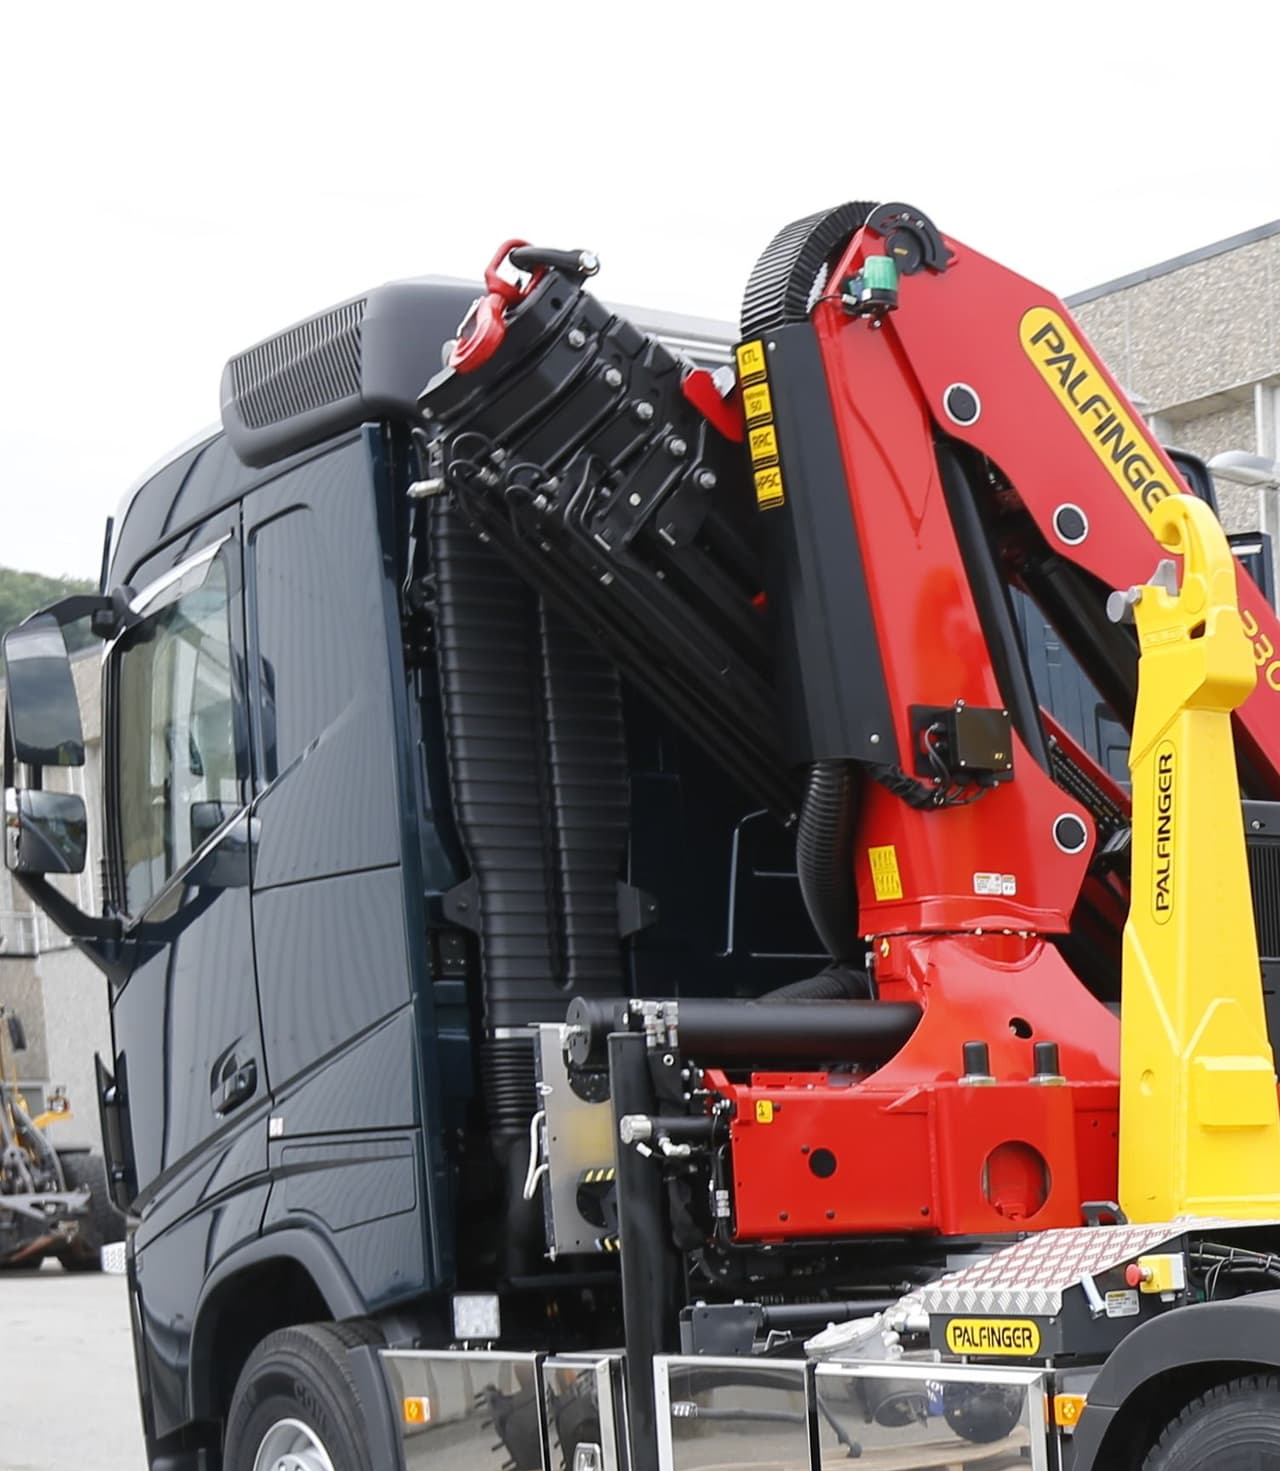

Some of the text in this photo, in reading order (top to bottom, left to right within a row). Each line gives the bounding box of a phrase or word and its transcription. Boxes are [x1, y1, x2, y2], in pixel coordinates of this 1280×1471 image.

[1030, 322, 1170, 513] PALFINGE
[1156, 753, 1173, 911] PALFINGER
[953, 1326, 1034, 1349] PALFINGER
